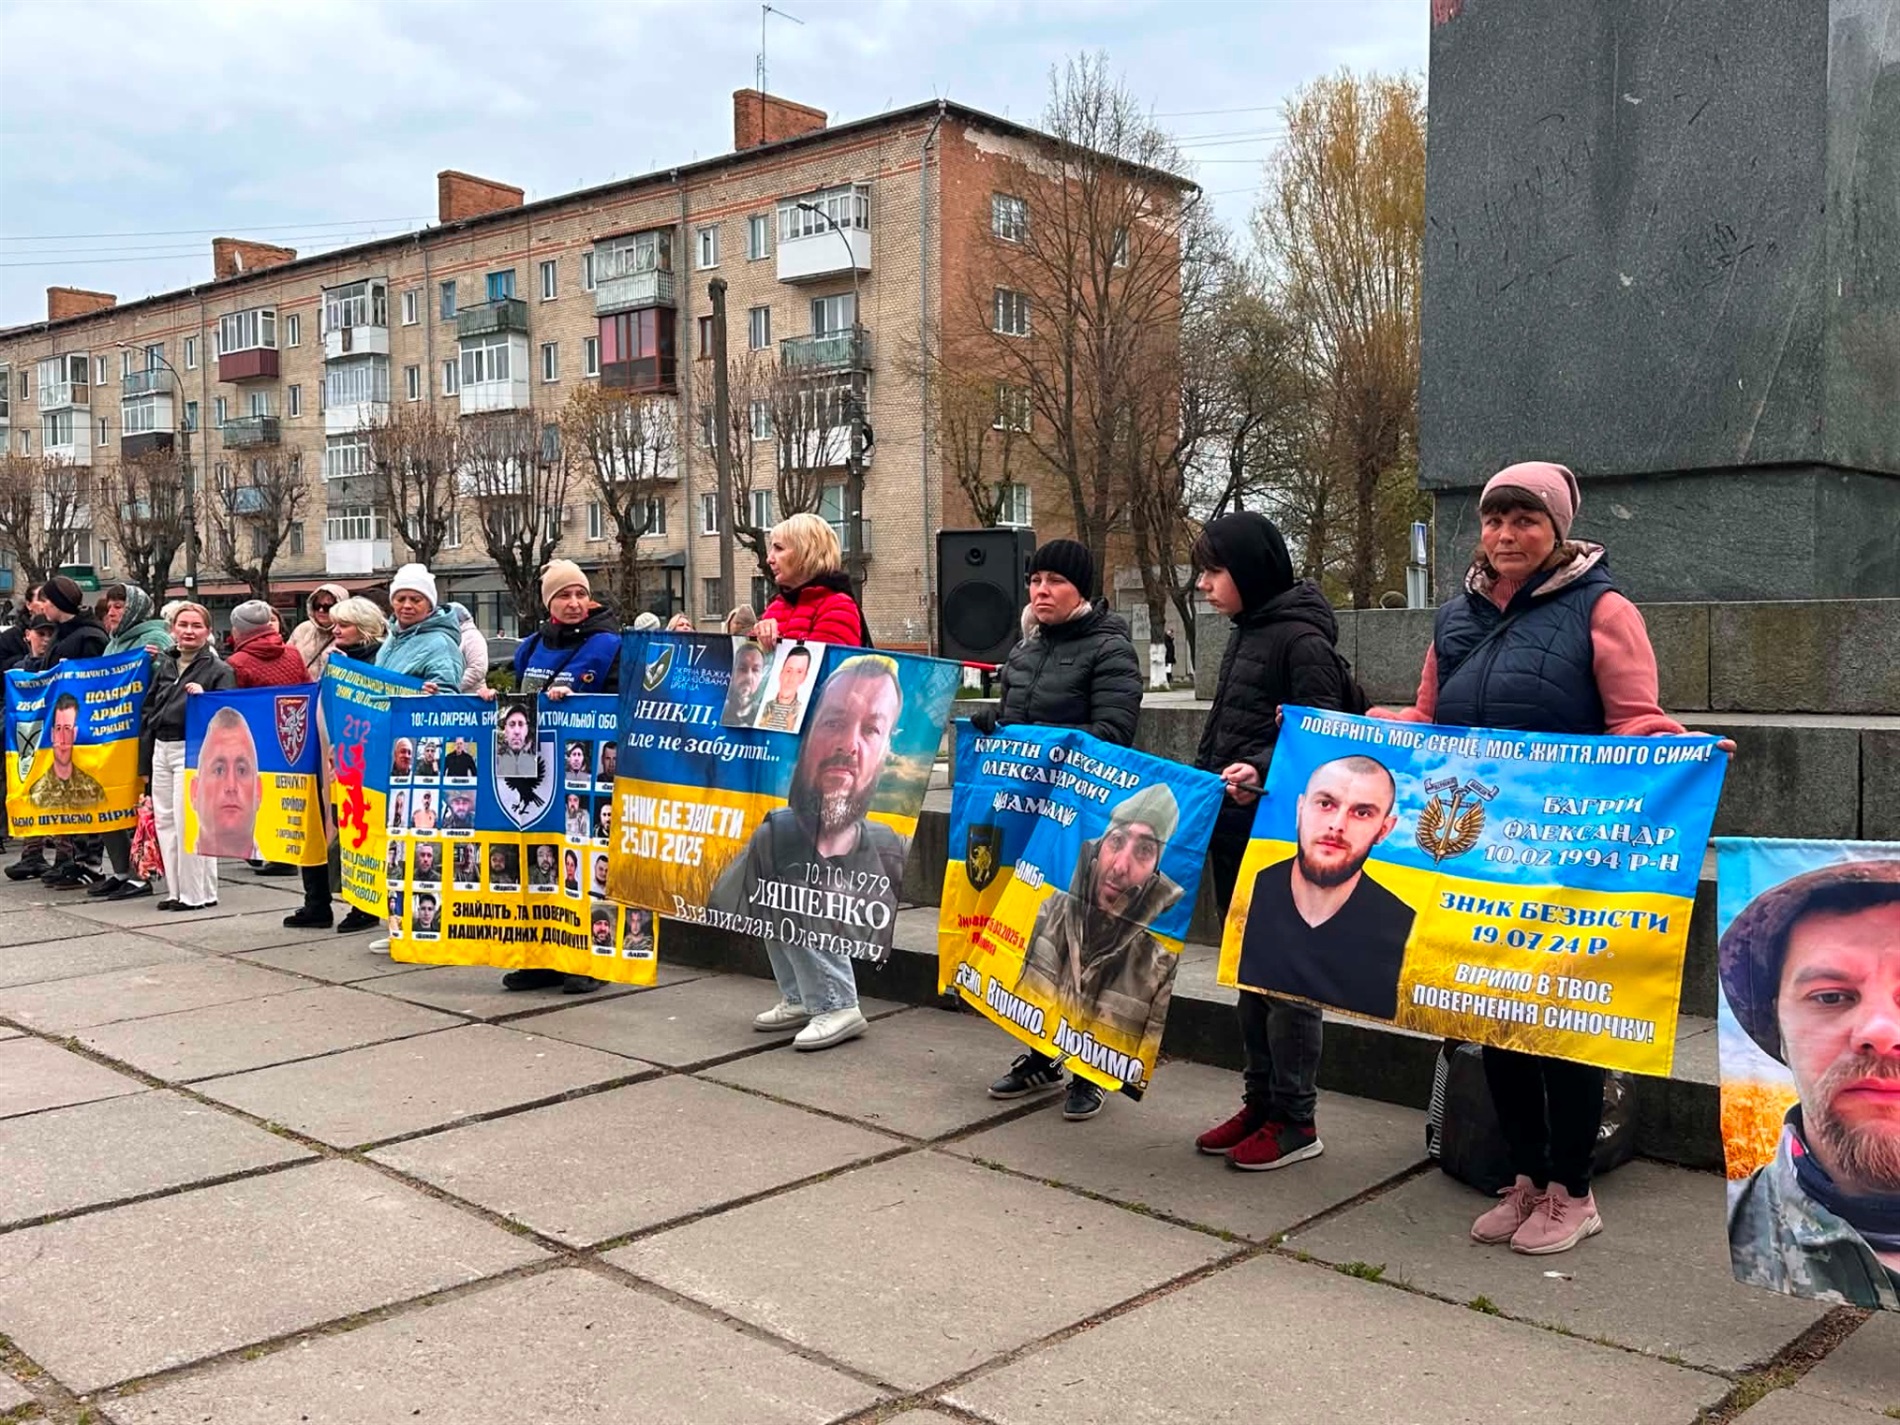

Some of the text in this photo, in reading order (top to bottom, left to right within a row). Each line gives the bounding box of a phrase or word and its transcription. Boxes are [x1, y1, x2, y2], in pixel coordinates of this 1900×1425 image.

[689, 644, 706, 666] 17
[342, 714, 372, 744] 212
[658, 735, 682, 751] не
[1300, 715, 1384, 744] ПОВЕРНІТЬ
[1387, 728, 1424, 750] МОЄ
[1427, 733, 1482, 759] СЕРЦЕ,
[1485, 738, 1526, 760] МОЄ
[1653, 742, 1713, 766] СИНА!
[1503, 819, 1676, 848] ОЛЕКСАНДР
[1484, 844, 1680, 873] 10.02.1994 Р-Н
[804, 862, 891, 898] 10.10.1979
[452, 900, 511, 921] ЗНАЙДІТЬ
[748, 877, 892, 931] ЛЯШЕНКО
[1438, 890, 1671, 935] ЗНИК БЕЗВІСТИ
[1472, 924, 1581, 955] 19.07.24
[1454, 963, 1614, 1005] ВІРИМО В ТВОЄ
[1412, 984, 1657, 1045] ПОВЕРНЕННЯ СИНОЧКУ!
[1052, 1014, 1150, 1089] Любимо.
